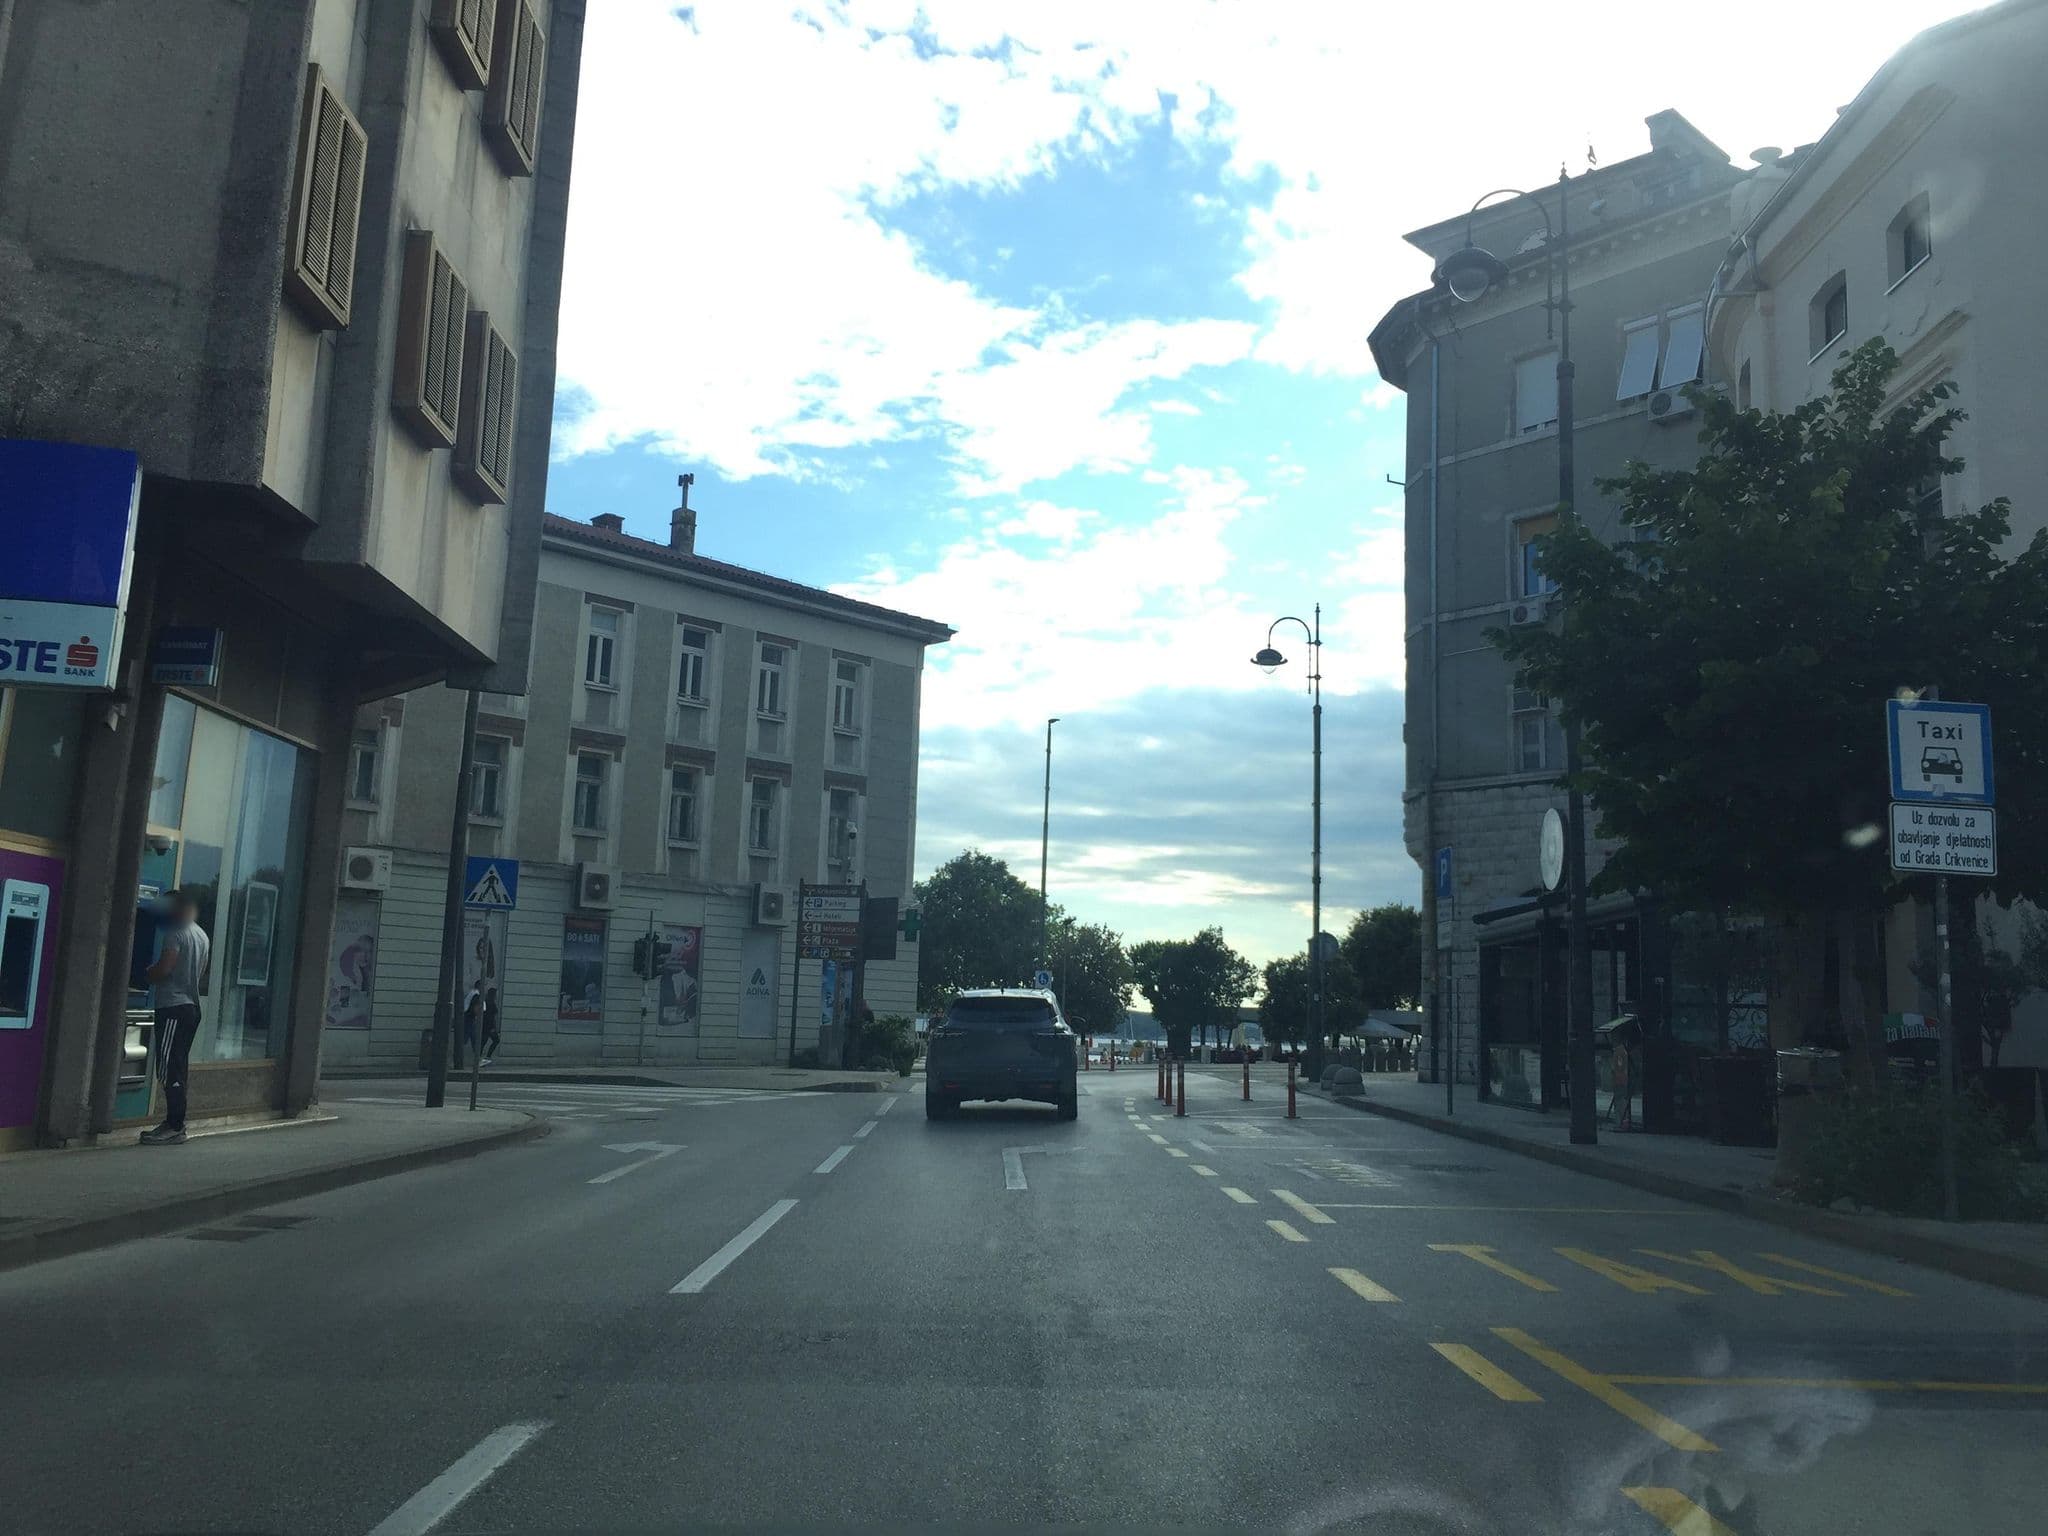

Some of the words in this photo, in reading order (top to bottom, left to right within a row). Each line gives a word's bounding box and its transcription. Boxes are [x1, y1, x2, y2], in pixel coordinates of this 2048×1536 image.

[64, 667, 96, 677] BANK
[1917, 721, 1963, 741] Taxi
[1911, 810, 1924, 825] Uz
[1928, 812, 1960, 827] dozvolu
[1964, 817, 1975, 828] za
[1897, 830, 1940, 847] obavljanje
[1946, 832, 1991, 850] djelatnosti
[1900, 850, 1910, 864] od
[1915, 850, 1940, 866] Grada
[1945, 852, 1989, 869] Crikvenice
[1427, 1243, 1916, 1297] TAXI
